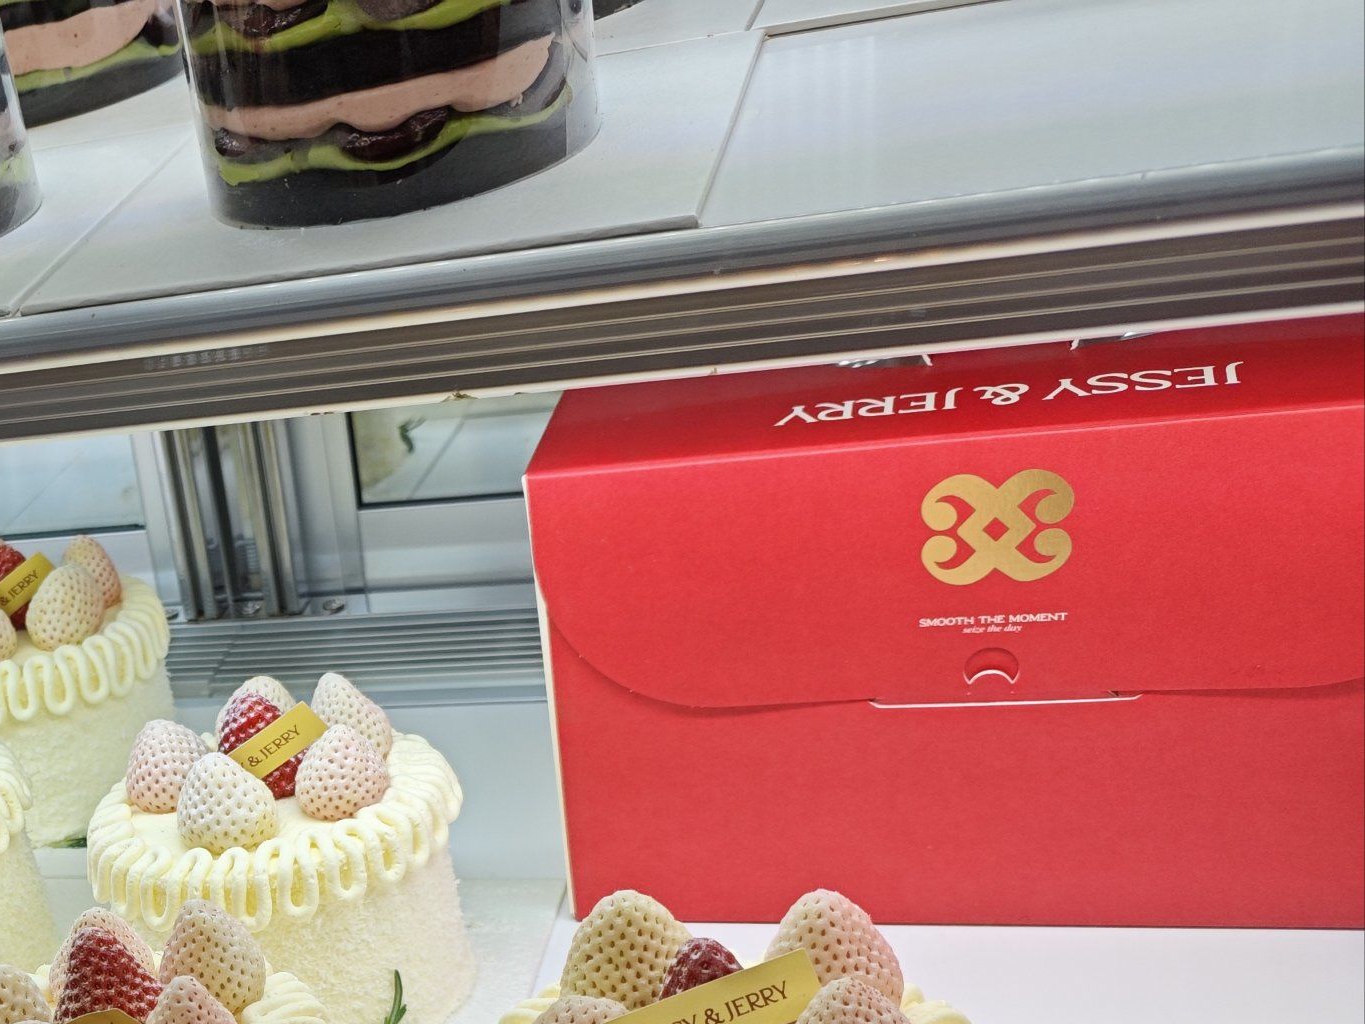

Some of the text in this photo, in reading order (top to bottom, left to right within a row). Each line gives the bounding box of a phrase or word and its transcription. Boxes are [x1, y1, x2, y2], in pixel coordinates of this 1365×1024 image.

[774, 361, 1244, 426] JESSY & JERRY
[8, 570, 38, 598] JERRY
[919, 612, 1068, 627] SMOOTH THE MOMENT
[962, 624, 1022, 634] seize the day
[247, 724, 300, 767] & JERRY
[724, 980, 788, 1021] JERRY
